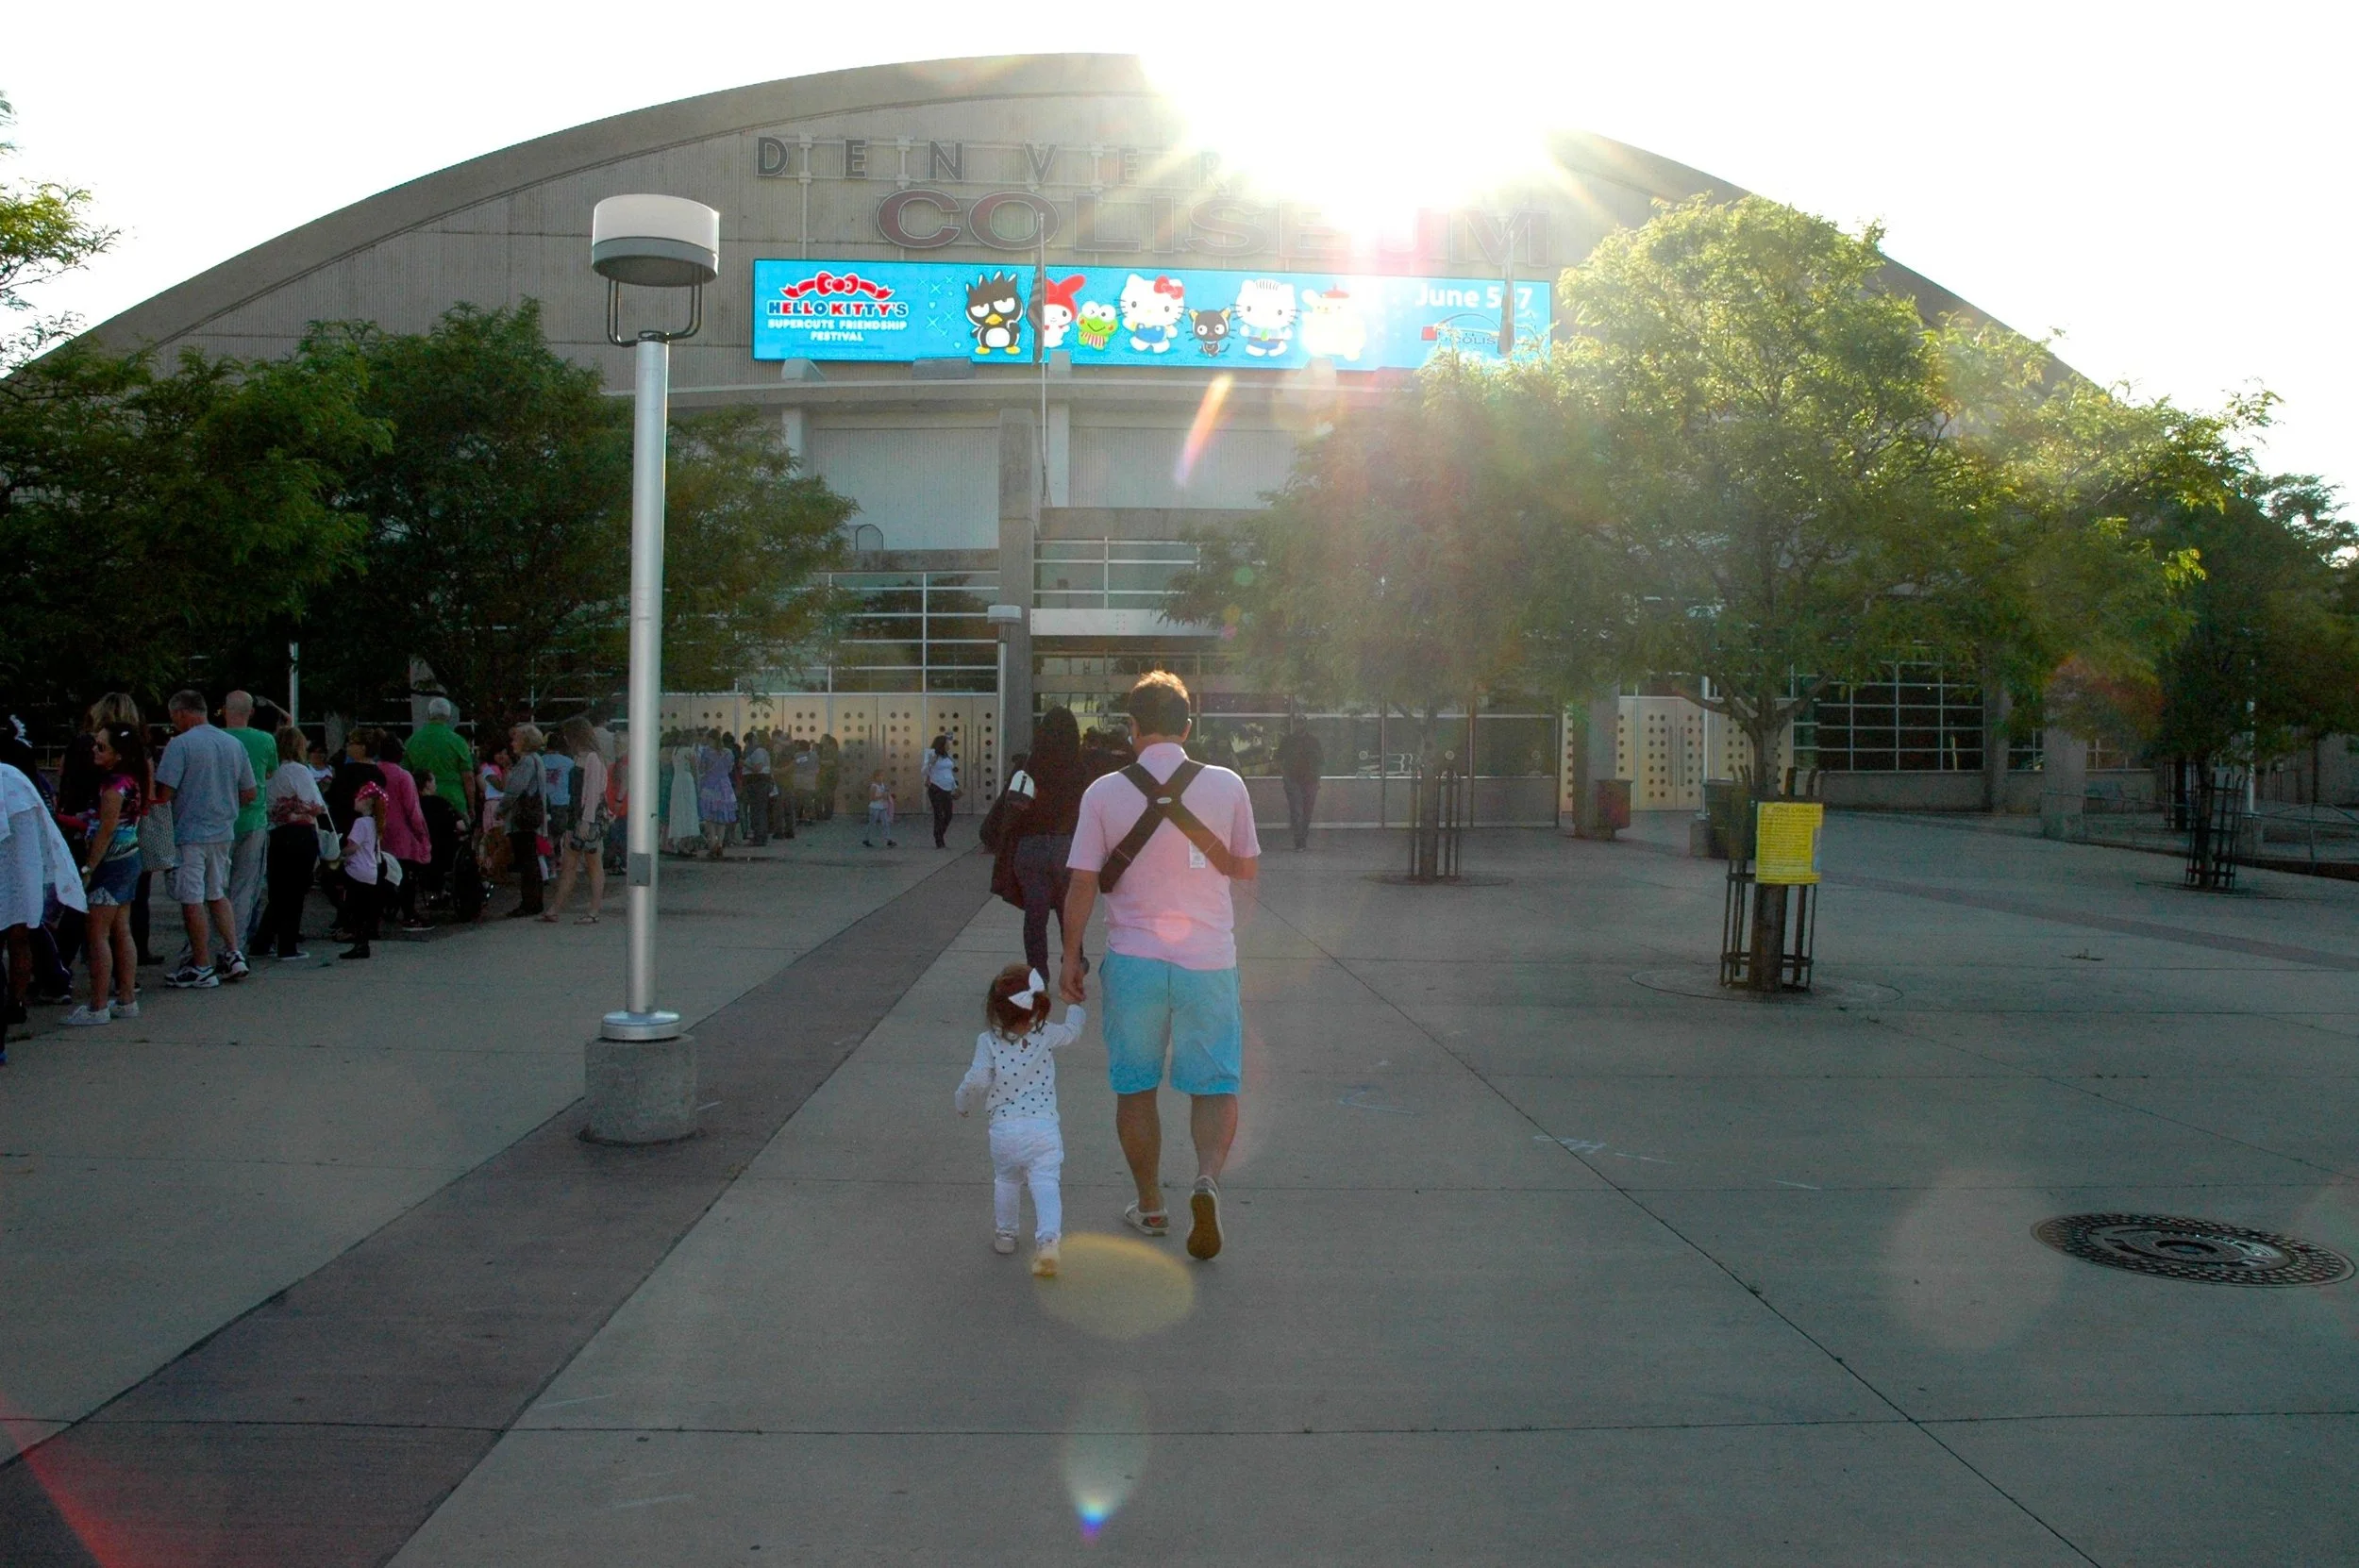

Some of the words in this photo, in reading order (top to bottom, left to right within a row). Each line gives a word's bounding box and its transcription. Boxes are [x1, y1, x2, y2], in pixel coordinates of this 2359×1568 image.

[757, 137, 1224, 190] DENVER
[877, 189, 1551, 268] COLISEUM
[1416, 283, 1480, 309] June
[767, 301, 828, 316] HELLO
[829, 302, 909, 317] KITTY'S
[767, 319, 835, 329] SUPERCUTE
[839, 320, 908, 330] FRIENDSHIP
[810, 331, 864, 342] FESTIVAL
